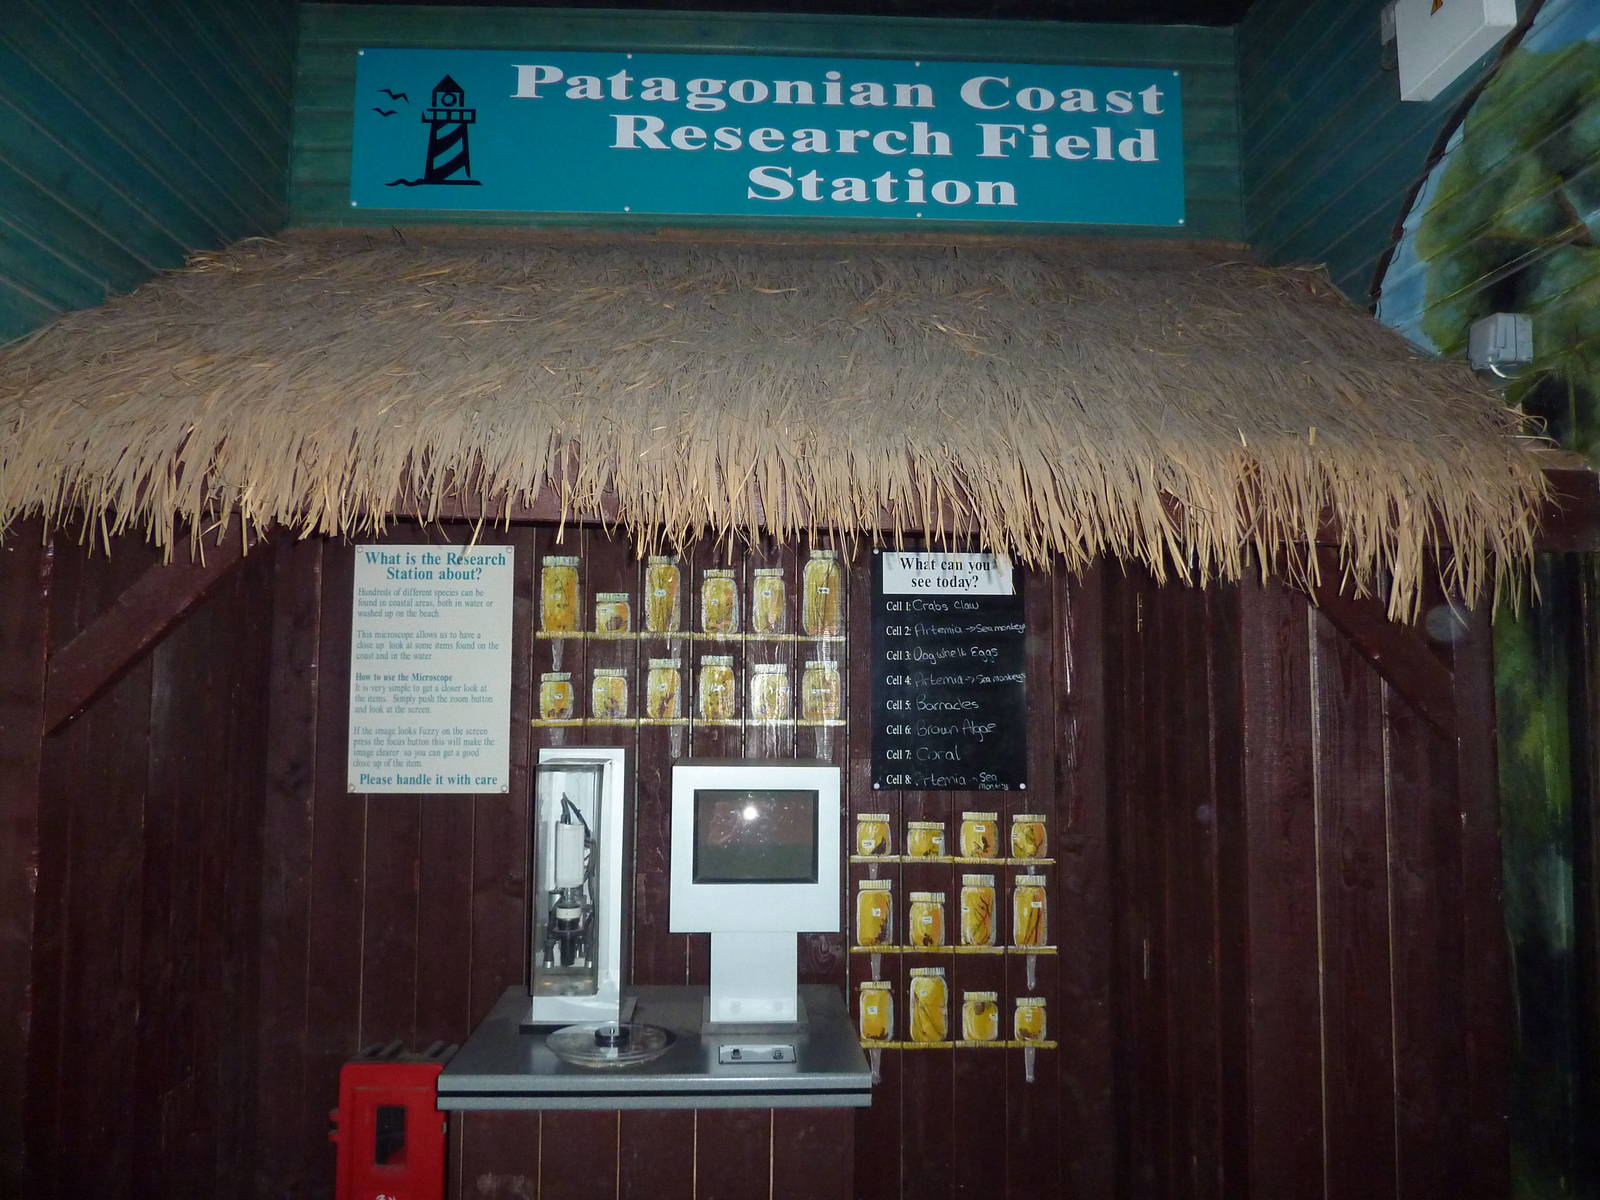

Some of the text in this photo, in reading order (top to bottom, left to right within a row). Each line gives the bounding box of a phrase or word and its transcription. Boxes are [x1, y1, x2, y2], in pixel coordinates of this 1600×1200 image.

[510, 64, 1165, 116] Patagonian Coast
[609, 113, 1159, 163] Research Field
[747, 165, 1018, 207] Station
[365, 552, 506, 565] What is the Research
[901, 558, 990, 574] What can you
[387, 567, 482, 580] Station about?
[912, 576, 979, 591] see today?
[358, 588, 391, 596] Hundreds
[393, 588, 401, 596] of
[403, 588, 432, 597] different
[434, 589, 459, 599] species
[476, 589, 484, 597] be
[437, 599, 453, 607] both
[455, 599, 462, 607] in
[886, 602, 902, 611] Cell
[912, 599, 949, 612] Crabs
[358, 609, 383, 617] washed
[385, 611, 393, 619] up
[406, 609, 416, 617] the
[357, 630, 372, 638] This
[375, 631, 414, 640] microscope
[416, 631, 437, 639] allows
[450, 631, 457, 639] to
[459, 631, 474, 639] have
[886, 626, 902, 635] Cell
[904, 626, 911, 635] 2:
[914, 624, 963, 637] Artemia
[456, 642, 475, 650] found
[488, 642, 499, 650] the
[400, 652, 411, 660] the
[886, 651, 902, 660] Cell
[905, 651, 911, 660] 3:
[970, 647, 998, 663] Eggs
[356, 673, 371, 681] How
[398, 673, 409, 681] the
[412, 673, 453, 683] Microscope
[886, 675, 902, 685] Cell
[904, 676, 911, 685] 4:
[915, 672, 963, 687] Artemia
[389, 684, 411, 693] simple
[423, 685, 432, 693] get
[355, 694, 366, 702] the
[393, 695, 415, 705] Simply
[418, 695, 433, 705] push
[436, 695, 449, 703] the
[472, 695, 493, 703] button
[886, 700, 902, 710] Cell
[904, 700, 911, 710] 5:
[375, 728, 395, 736] image
[398, 727, 416, 735] looks
[419, 727, 439, 736] fuzzy
[452, 727, 463, 735] the
[886, 718, 997, 742] Cell 6: Brown Algae
[353, 739, 371, 747] press
[374, 737, 384, 745] the
[387, 737, 405, 745] focus
[353, 749, 374, 758] image
[414, 751, 426, 759] you
[443, 750, 453, 759] get
[462, 749, 479, 759] good
[886, 745, 961, 761] Cell 7: Coral
[360, 774, 498, 785] Please handle it with care
[886, 775, 902, 785] Cell
[905, 775, 911, 785] 8:
[979, 772, 997, 782] Sea
